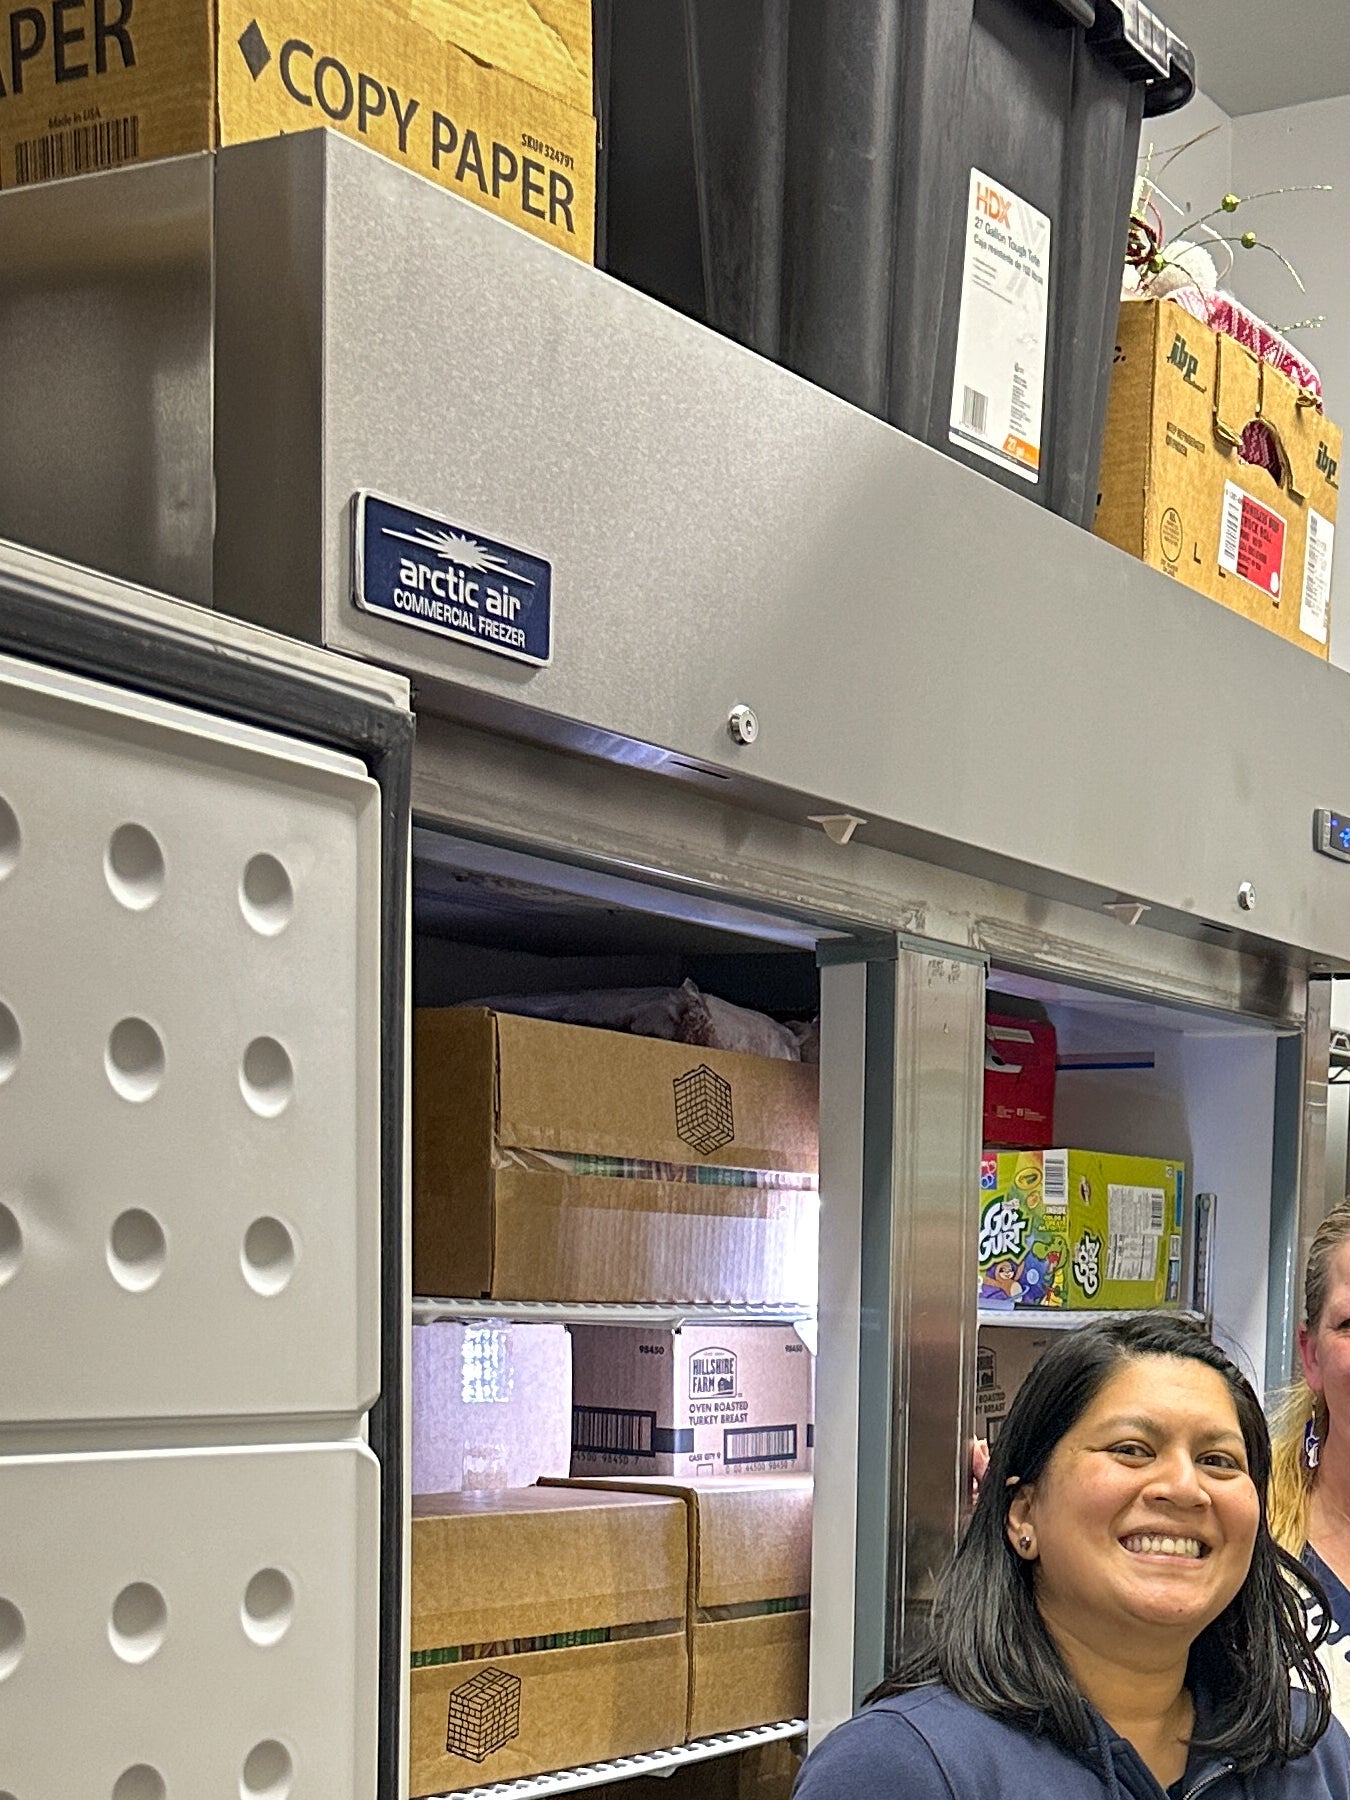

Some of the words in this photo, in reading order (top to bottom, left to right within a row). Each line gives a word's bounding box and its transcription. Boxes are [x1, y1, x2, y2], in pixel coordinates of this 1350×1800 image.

[0, 0, 137, 98] PER
[279, 38, 420, 154] COPY
[432, 110, 576, 235] PAPER
[976, 181, 1011, 230] HDX
[975, 216, 983, 229] 27
[400, 557, 480, 609] arctic
[486, 585, 521, 621] air
[393, 588, 476, 633] COMMERCIAL
[478, 615, 526, 649] FREEZER
[693, 1358, 734, 1375] HILLSHIRE
[693, 1376, 715, 1393] FARM
[689, 1403, 711, 1413] OVEN
[714, 1401, 748, 1412] ROASTED
[689, 1415, 718, 1426] TURKEY
[720, 1413, 748, 1424] BREAST
